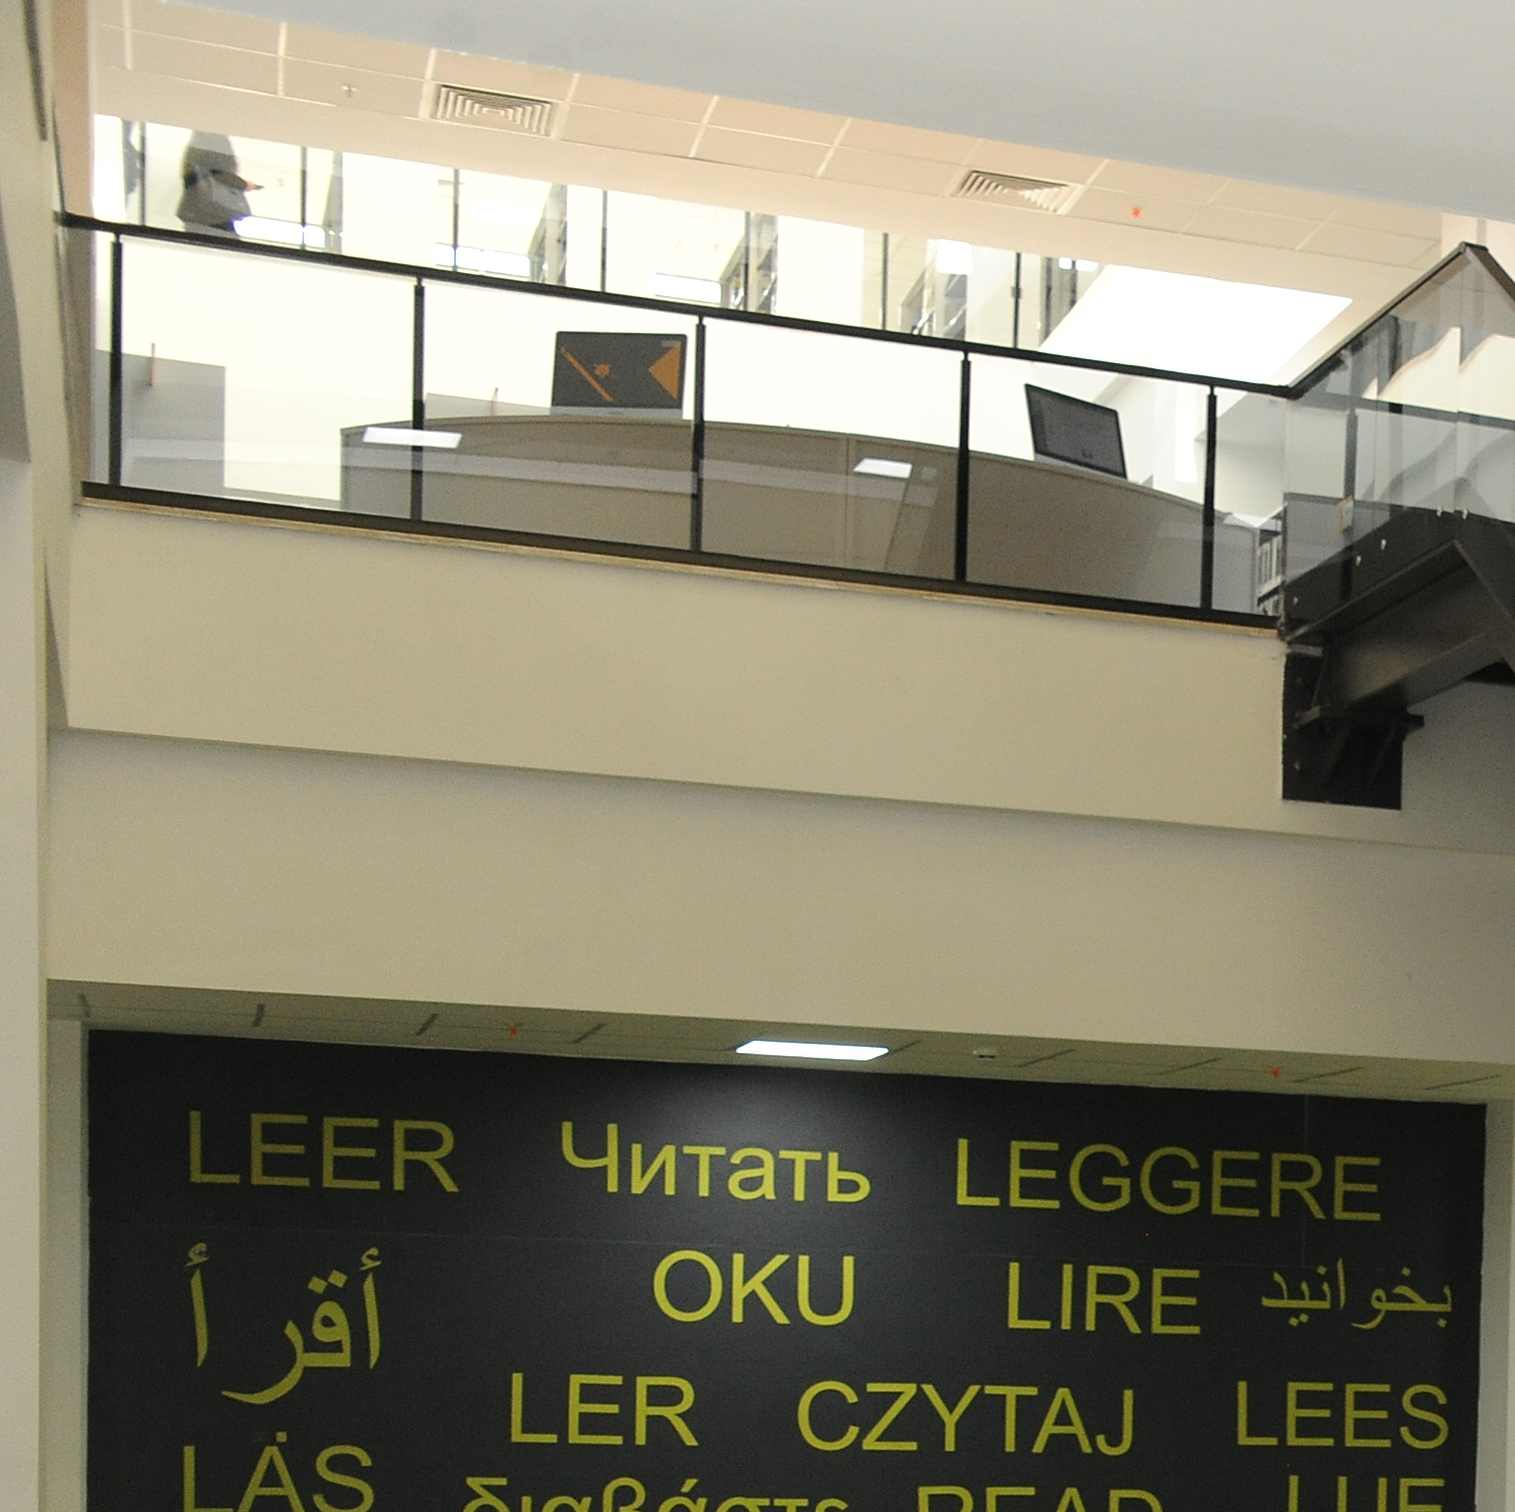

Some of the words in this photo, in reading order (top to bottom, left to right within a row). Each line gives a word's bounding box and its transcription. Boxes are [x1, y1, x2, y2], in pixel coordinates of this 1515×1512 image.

[191, 1115, 458, 1192] LEER
[562, 1121, 872, 1204] Читать
[956, 1138, 1380, 1220] LEGGERE
[652, 1248, 856, 1327] OKU
[1007, 1262, 1200, 1334] LIRE
[511, 1372, 699, 1446] LER
[797, 1380, 1133, 1456] CZYTAJ
[1238, 1381, 1448, 1449] LEES
